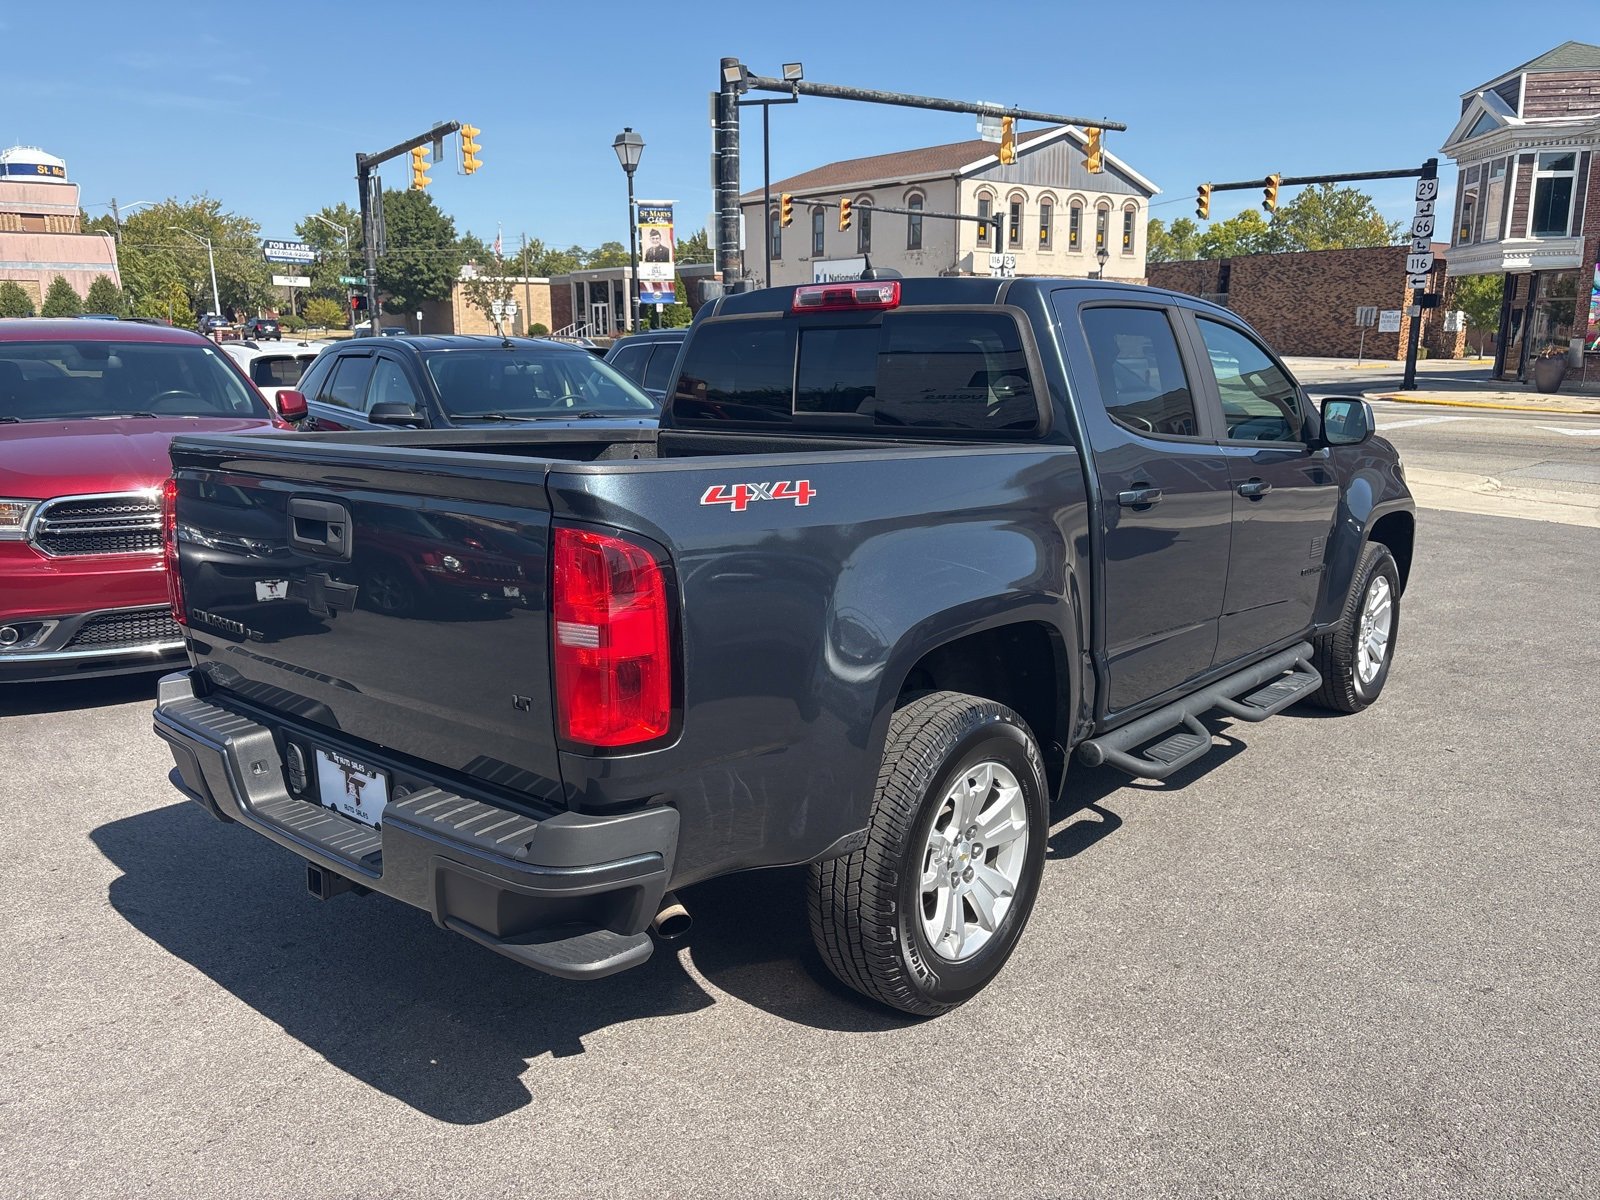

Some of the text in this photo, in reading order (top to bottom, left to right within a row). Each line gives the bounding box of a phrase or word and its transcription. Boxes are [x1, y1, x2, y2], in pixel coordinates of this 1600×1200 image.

[37, 165, 51, 175] St.
[1419, 182, 1434, 196] 29
[1415, 220, 1430, 233] 66
[268, 241, 310, 252] FOR LEASE
[991, 256, 1000, 264] 116
[1005, 255, 1015, 264] 29
[1411, 259, 1427, 269] 116
[192, 607, 244, 634] COLORADO
[512, 694, 532, 712] LT
[339, 756, 351, 767] AUTO
[350, 760, 365, 773] SALES
[343, 803, 369, 820] AUTO SALES
